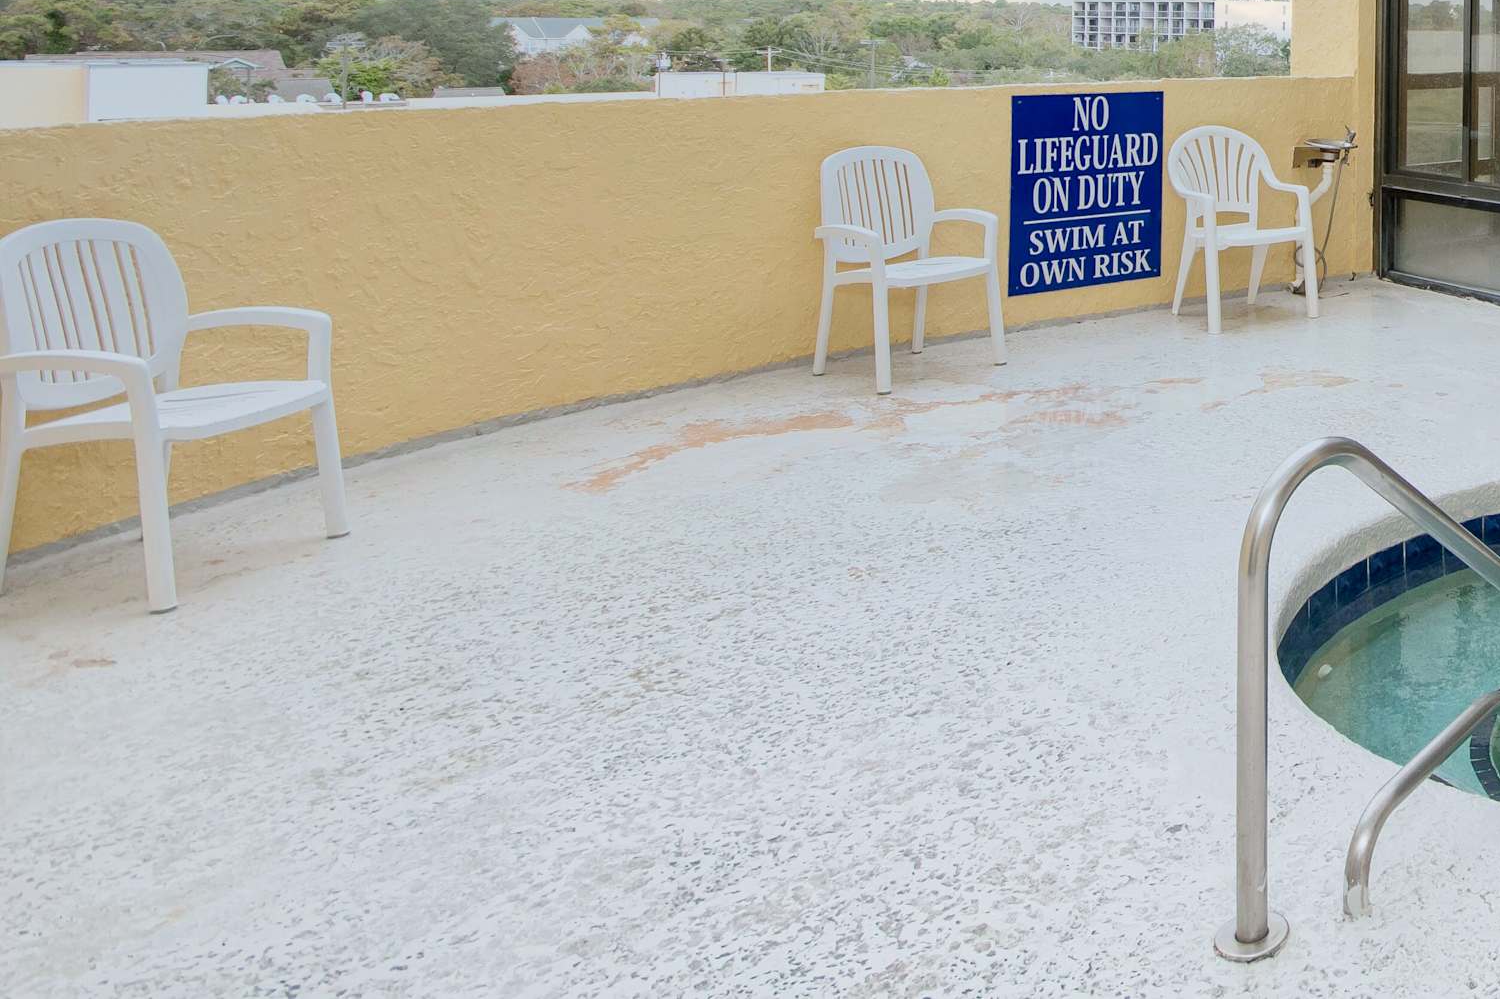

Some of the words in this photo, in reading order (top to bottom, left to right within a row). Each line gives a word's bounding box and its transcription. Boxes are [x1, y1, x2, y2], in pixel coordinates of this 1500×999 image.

[1072, 95, 1110, 132] NO
[1017, 132, 1159, 175] LIFEGUARD
[1032, 176, 1070, 215] ON
[1077, 171, 1145, 211] DUTY
[1029, 224, 1106, 256] SWIM
[1112, 220, 1145, 246] AT
[1019, 257, 1087, 288] OWN
[1093, 249, 1152, 279] RISK
